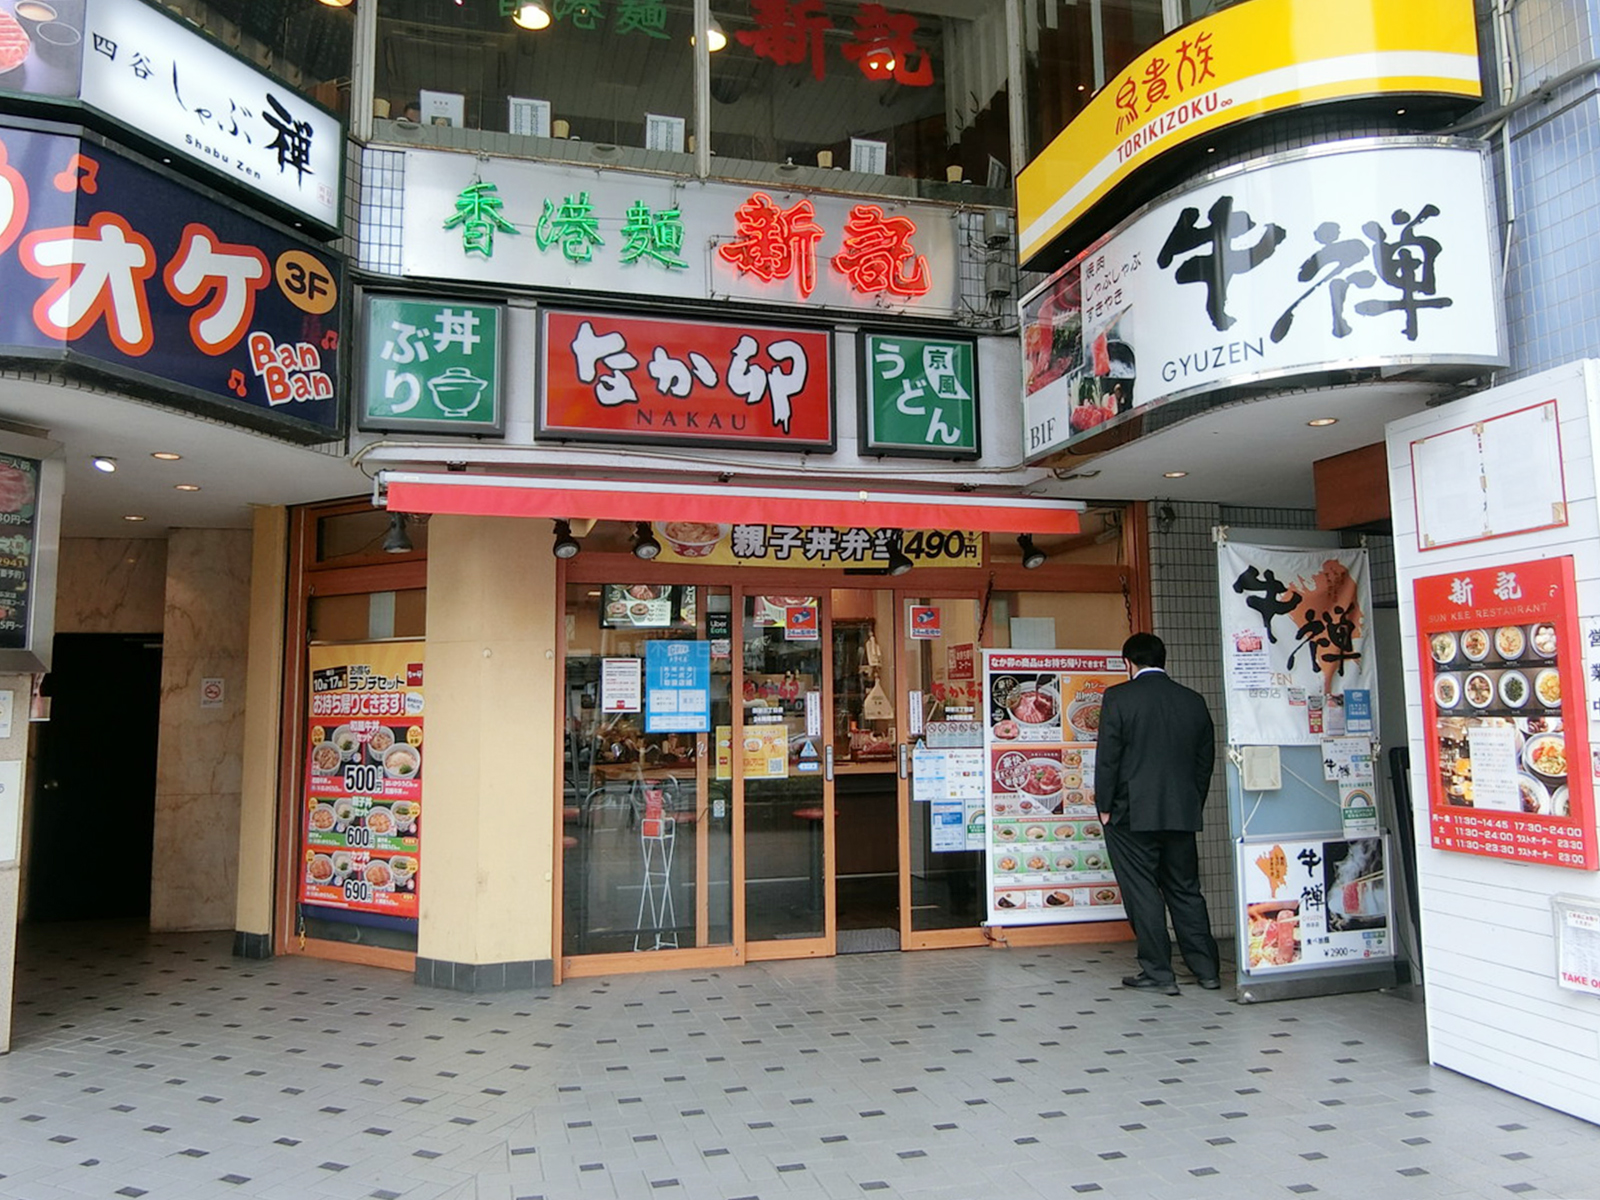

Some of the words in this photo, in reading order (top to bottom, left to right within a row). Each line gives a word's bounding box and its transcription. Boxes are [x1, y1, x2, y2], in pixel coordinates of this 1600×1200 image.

[1117, 92, 1218, 163] TORIKIZOKU
[185, 133, 229, 163] Shabu
[236, 159, 262, 180] Zen
[0, 140, 271, 356] オケ
[284, 262, 329, 300] 3F
[1086, 252, 1142, 302] しゃぶしゃぶ
[1086, 288, 1123, 323] すきやき
[249, 332, 321, 376] Ban
[433, 309, 480, 355] 丼
[571, 320, 808, 435] なか卯
[1161, 337, 1265, 382] GYUZEN
[262, 361, 333, 406] Ban
[636, 409, 747, 431] NAKAU
[1448, 571, 1522, 607] 新記
[1428, 613, 1447, 623] SUN
[1451, 609, 1471, 620] KEE
[1476, 602, 1548, 618] RESTAURANT
[349, 676, 405, 691] ランチセット
[1561, 972, 1588, 986] TAKE
[1591, 979, 1600, 989] O
